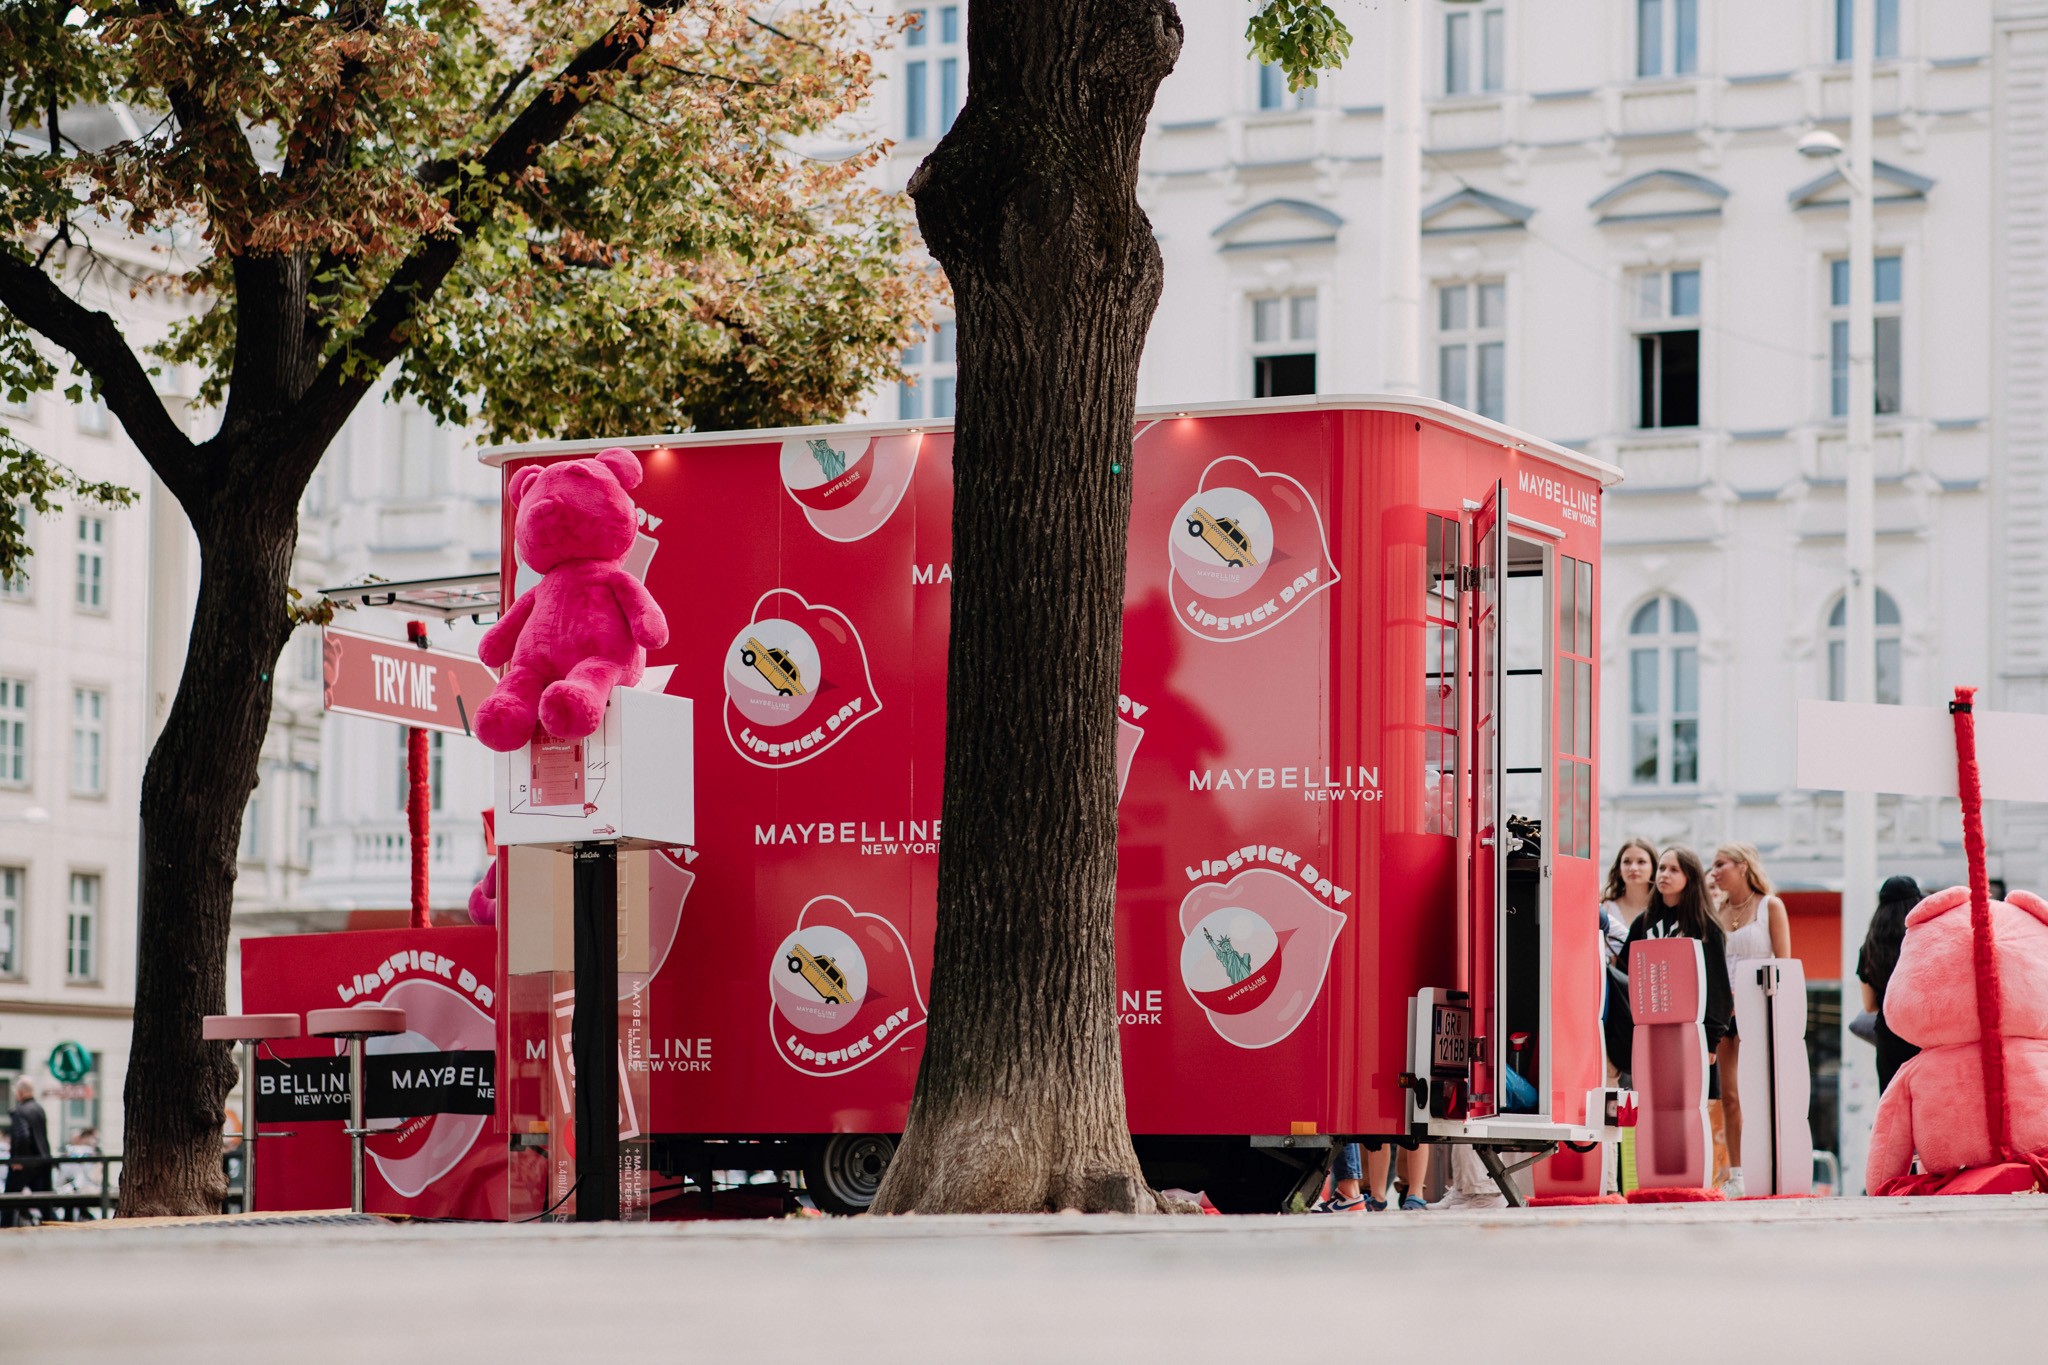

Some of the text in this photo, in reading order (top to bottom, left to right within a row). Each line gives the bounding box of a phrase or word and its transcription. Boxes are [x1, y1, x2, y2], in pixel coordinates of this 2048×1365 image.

[1519, 470, 1597, 515] MAYBELLINE
[1562, 507, 1597, 528] NEW YORK
[1186, 567, 1319, 631] LIPSTICK DAY
[371, 653, 438, 713] TRY ME
[740, 697, 862, 758] LIPSTICK DAY
[1189, 766, 1378, 790] MAYBELLIN
[1304, 789, 1346, 801] NEW
[862, 843, 898, 855] NEW
[1185, 845, 1352, 904] LIPSTICK DAY
[337, 950, 455, 1003] LIPSTICK
[633, 980, 641, 1069] MAYBELLINE
[1445, 1012, 1456, 1036] GR
[786, 1007, 909, 1066] LIPSTICK DAY
[1439, 1038, 1464, 1061] 121BB
[668, 1060, 712, 1072] YORK
[260, 1073, 351, 1095] BELLIN
[295, 1094, 322, 1105] NEW
[624, 1155, 632, 1180] CHILI
